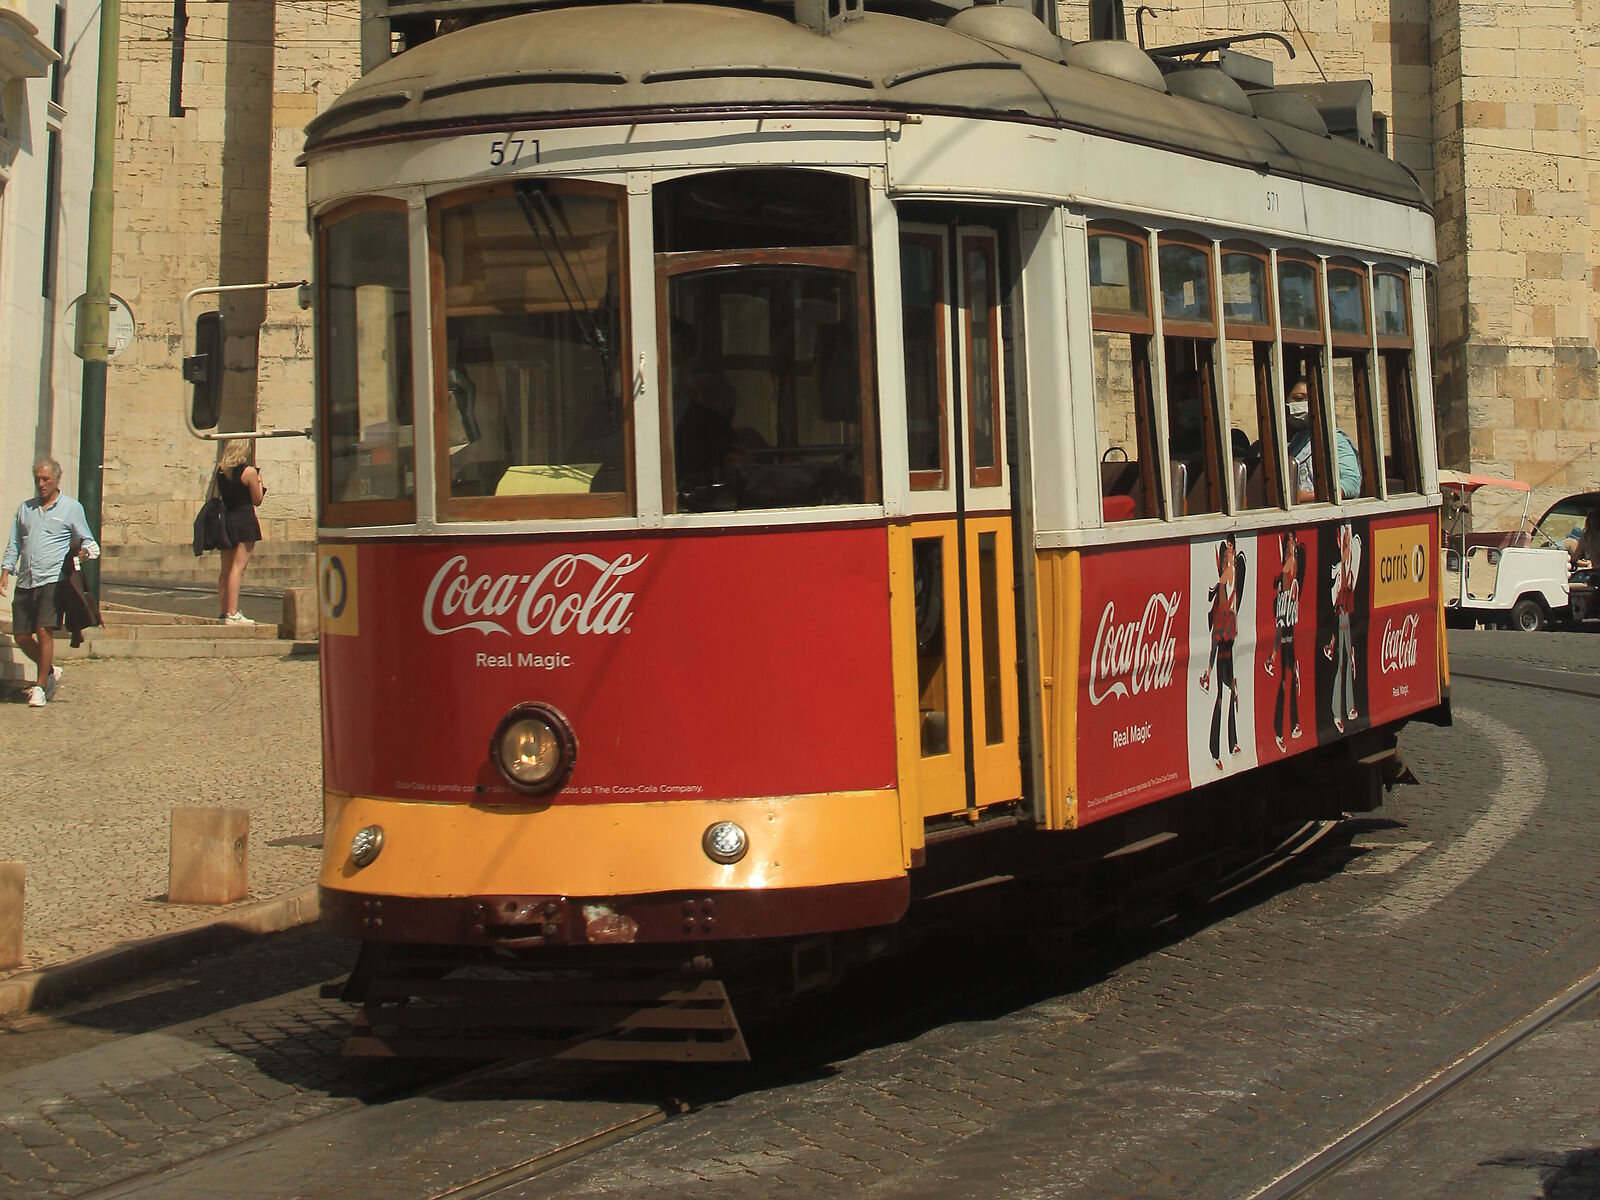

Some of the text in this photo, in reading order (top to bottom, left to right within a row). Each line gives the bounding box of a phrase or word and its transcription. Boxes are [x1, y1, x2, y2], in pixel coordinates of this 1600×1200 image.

[490, 139, 540, 166] 571
[1267, 191, 1279, 212] 571
[1380, 544, 1408, 583] carris
[422, 552, 649, 636] Coca-Cola
[1089, 590, 1183, 705] Coca-Cola
[1381, 613, 1419, 674] Coca-Cola
[476, 651, 571, 670] Real Magic
[1113, 721, 1151, 749] Real Magic
[594, 786, 610, 794] The
[612, 785, 657, 794] Coca-Cola
